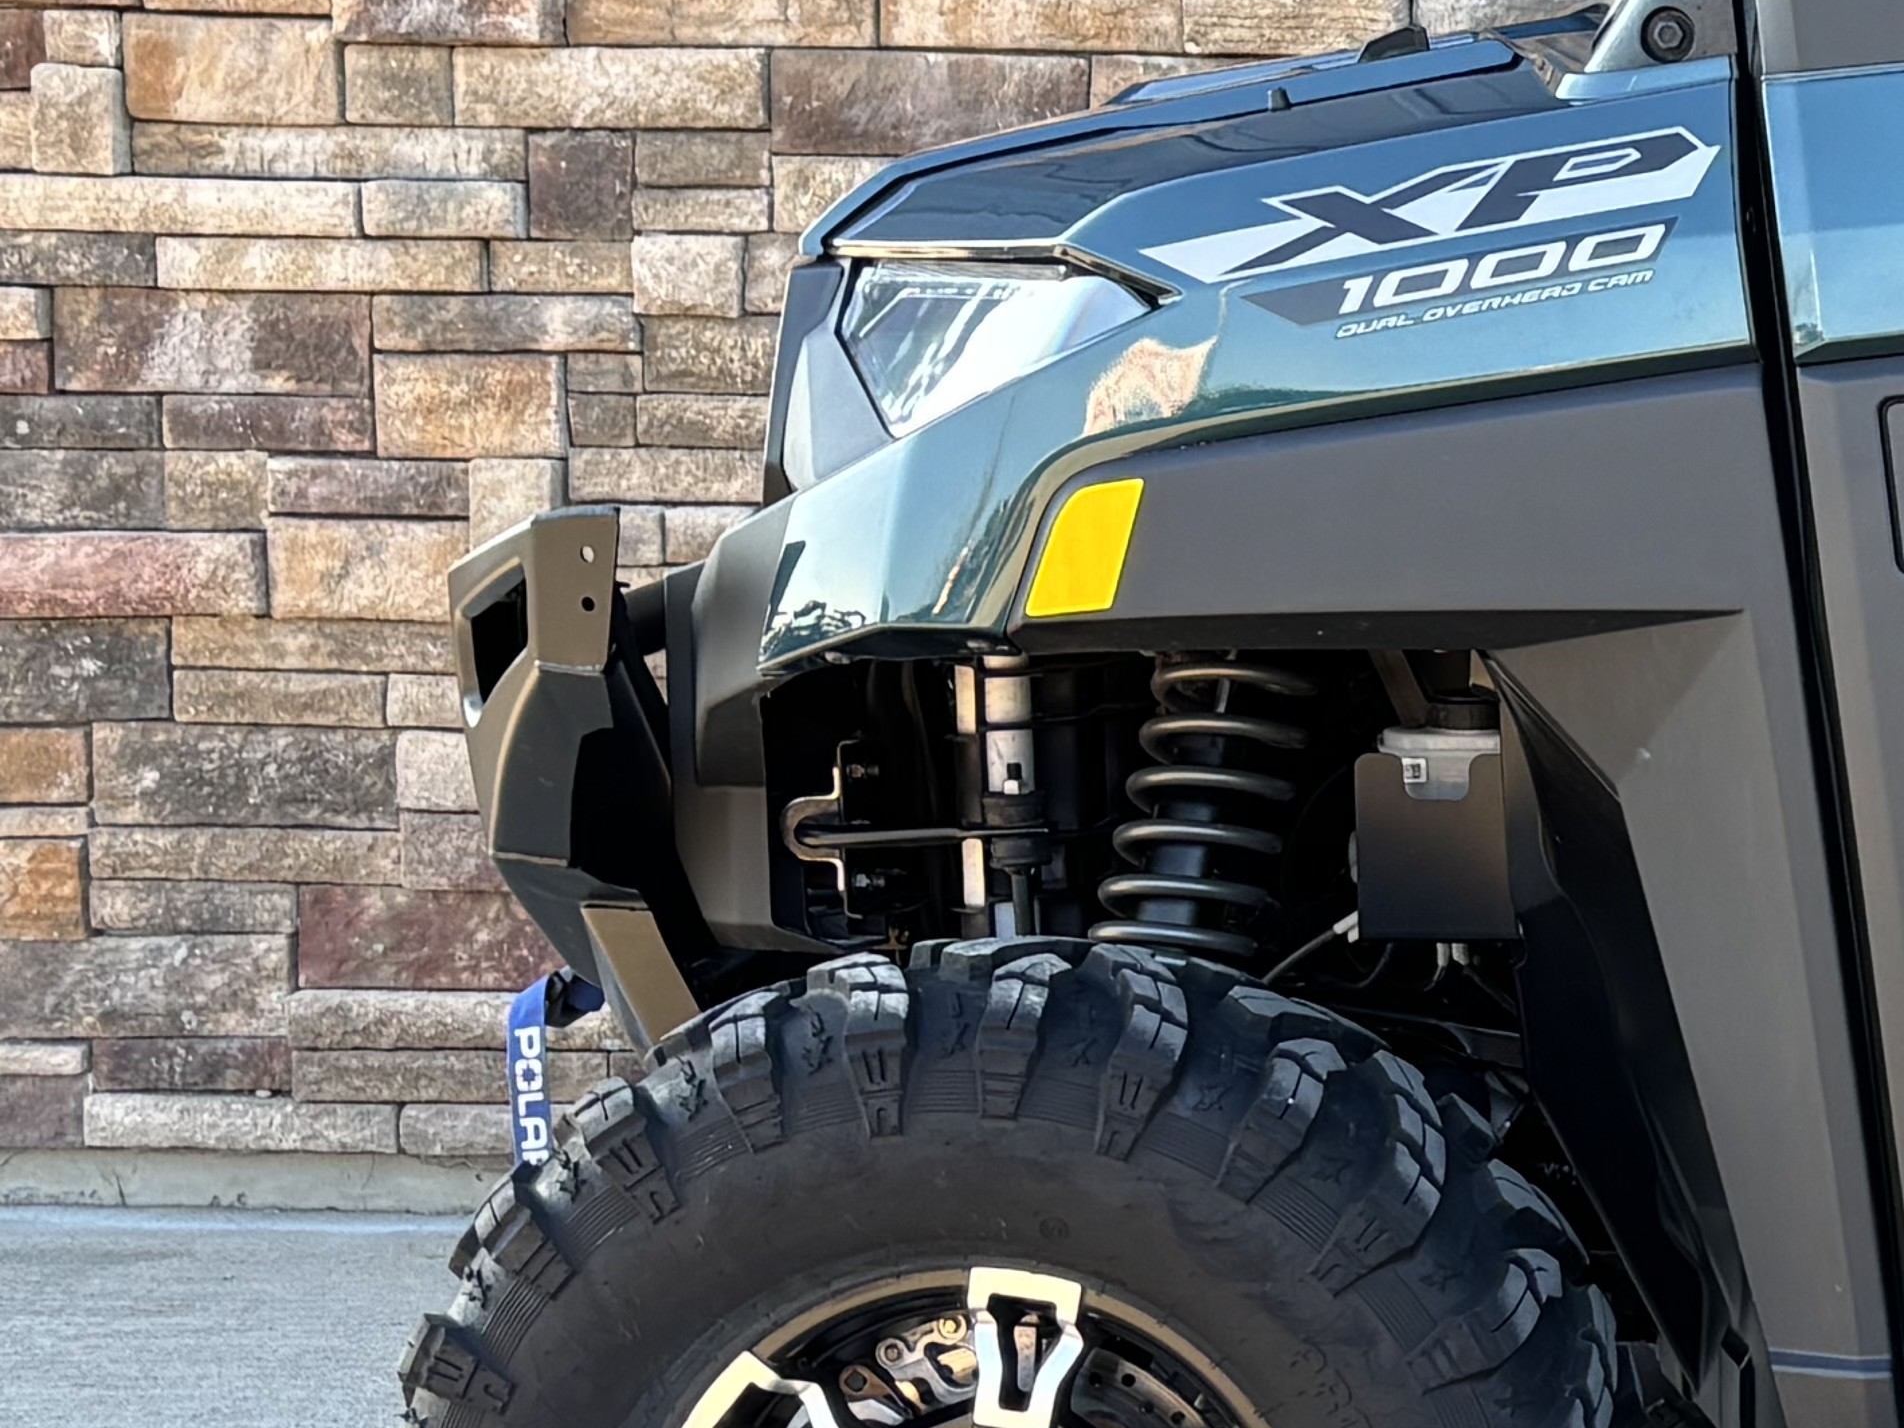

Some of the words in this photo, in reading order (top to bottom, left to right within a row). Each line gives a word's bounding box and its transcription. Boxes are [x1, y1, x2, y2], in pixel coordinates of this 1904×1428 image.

[1224, 129, 1702, 274] XP
[1335, 223, 1667, 316] 1000
[1335, 313, 1414, 339] DUAL
[1422, 282, 1582, 322] OVERHEAD
[1587, 269, 1655, 292] CAM
